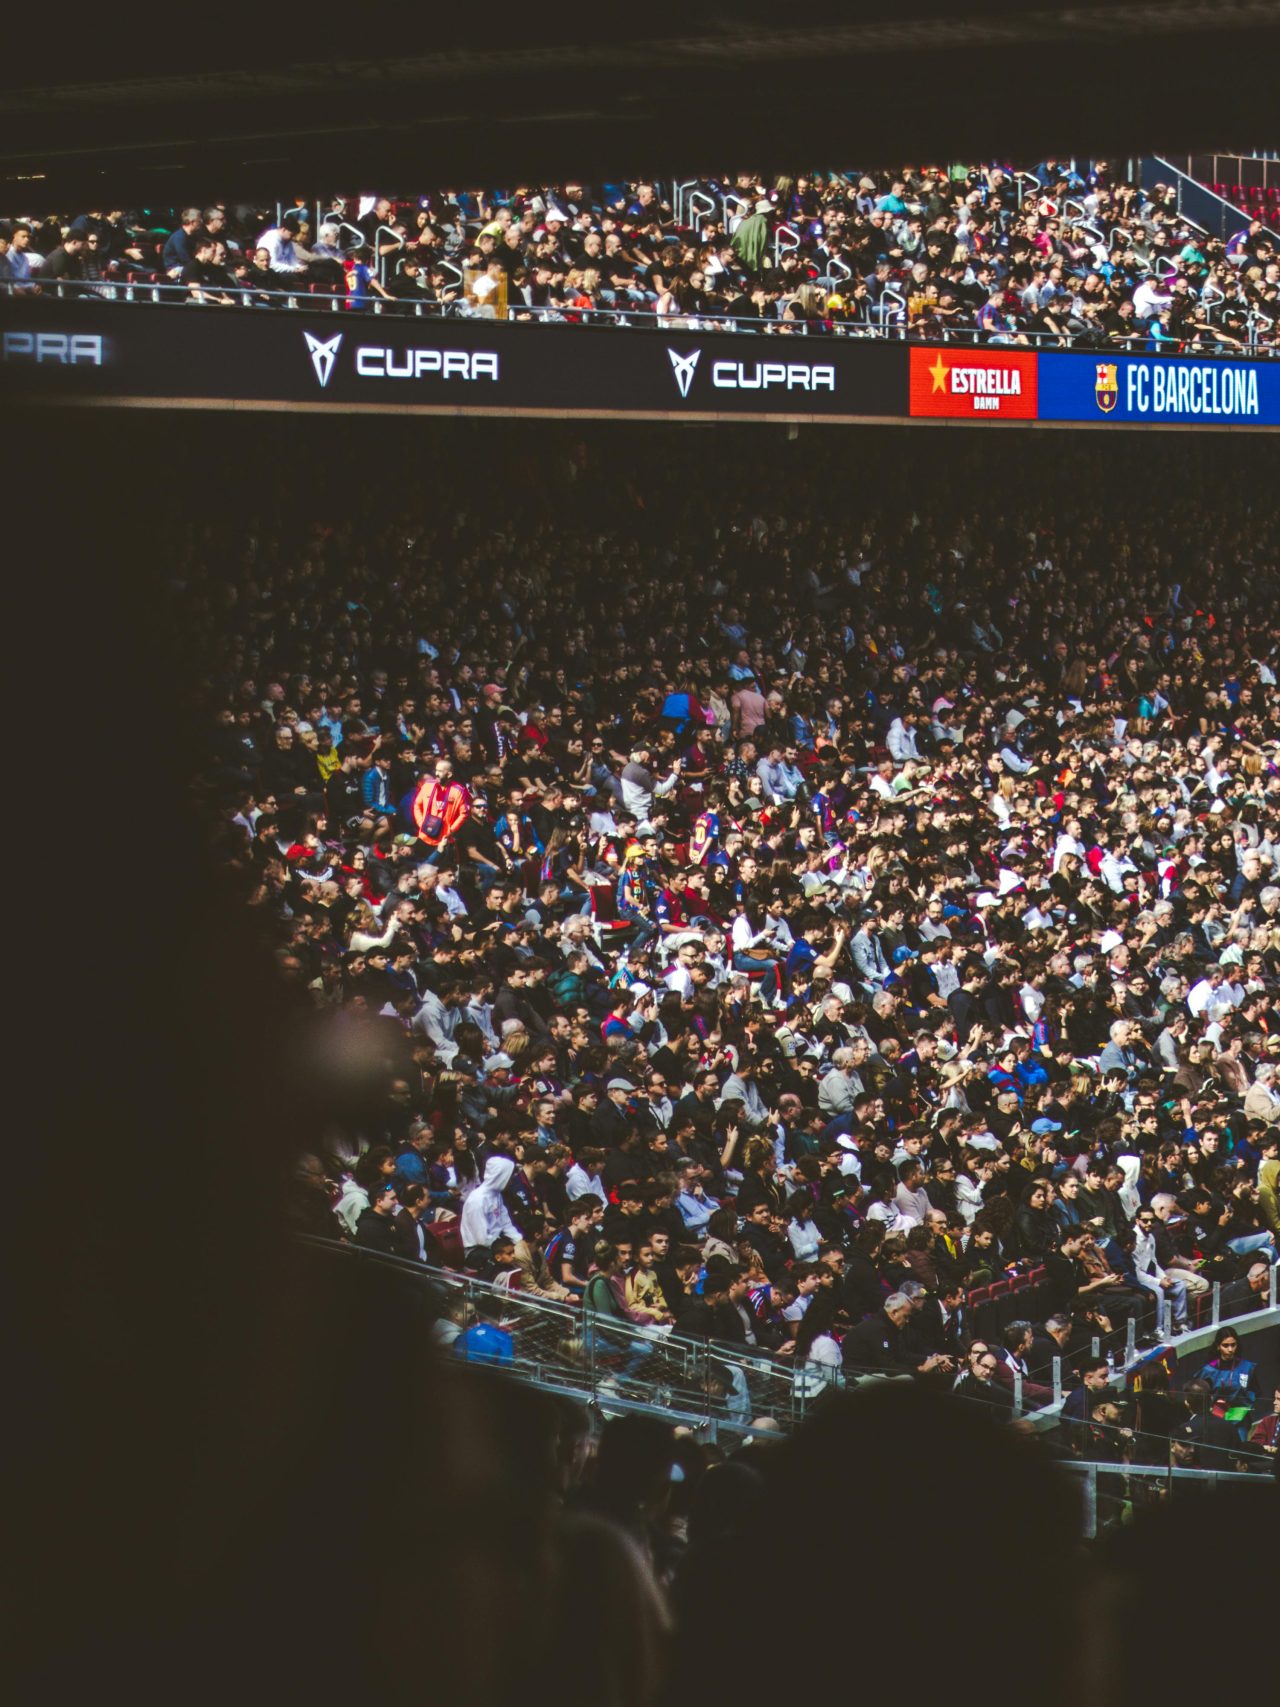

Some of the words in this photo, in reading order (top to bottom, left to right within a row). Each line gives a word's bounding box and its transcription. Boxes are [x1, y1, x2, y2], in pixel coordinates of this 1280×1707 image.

[356, 347, 498, 381] CUPRA
[712, 361, 835, 391] CUPRA
[951, 367, 1021, 395] ESTRELLA
[1127, 364, 1150, 413] FC
[1153, 365, 1259, 415] BARCELONA
[973, 396, 1000, 410] DAMM
